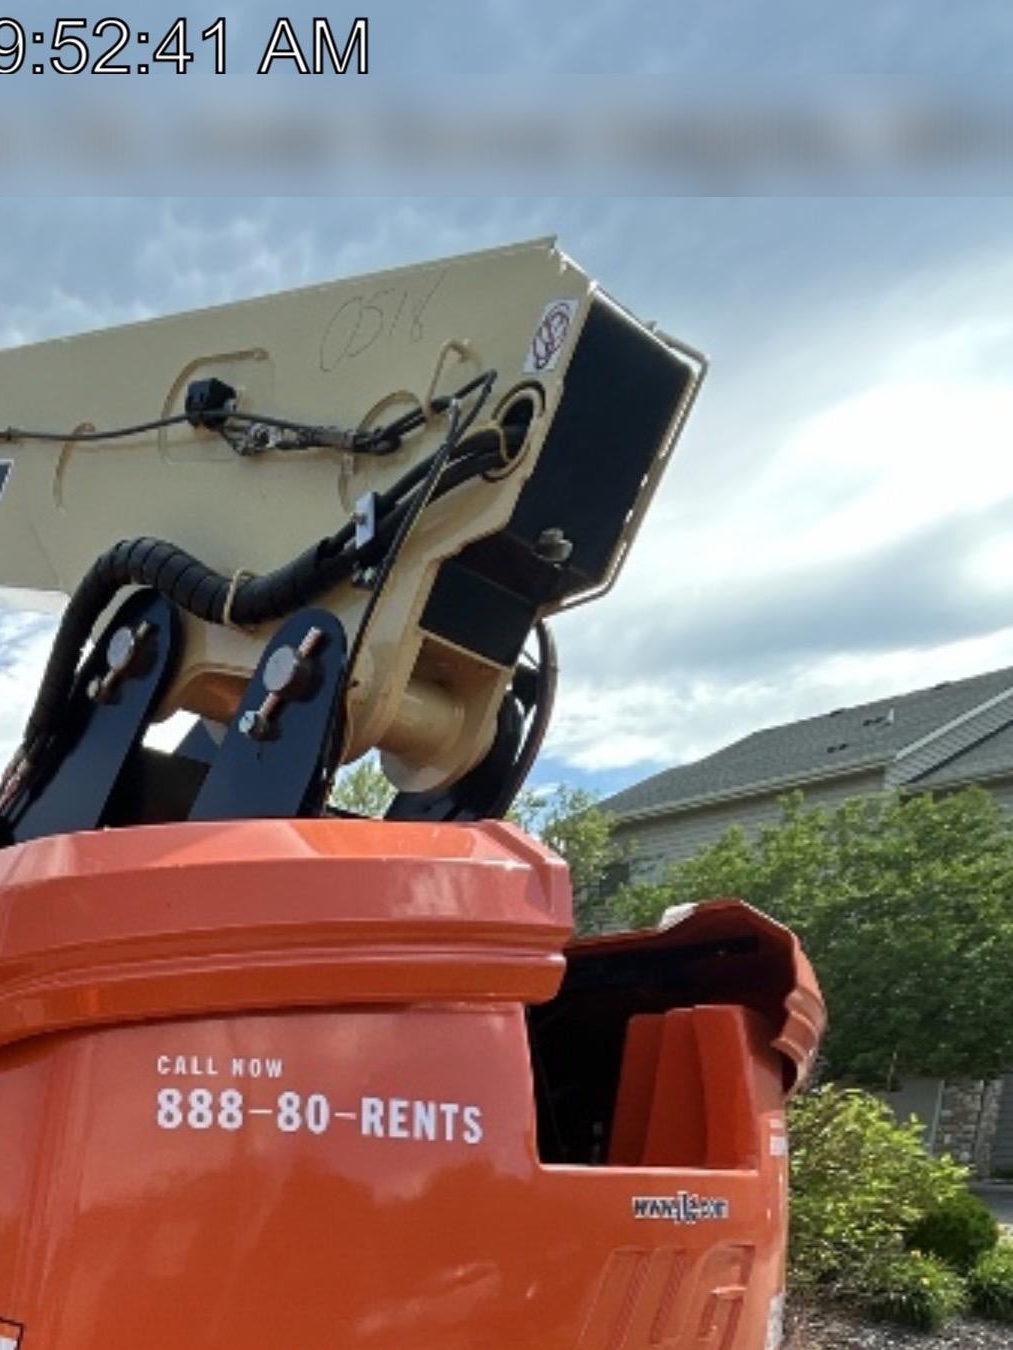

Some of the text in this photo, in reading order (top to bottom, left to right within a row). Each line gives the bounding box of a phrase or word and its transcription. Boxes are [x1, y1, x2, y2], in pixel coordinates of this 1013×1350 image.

[156, 1055, 284, 1079] CALL NOW
[156, 1087, 484, 1145] 888-80-RENTS
